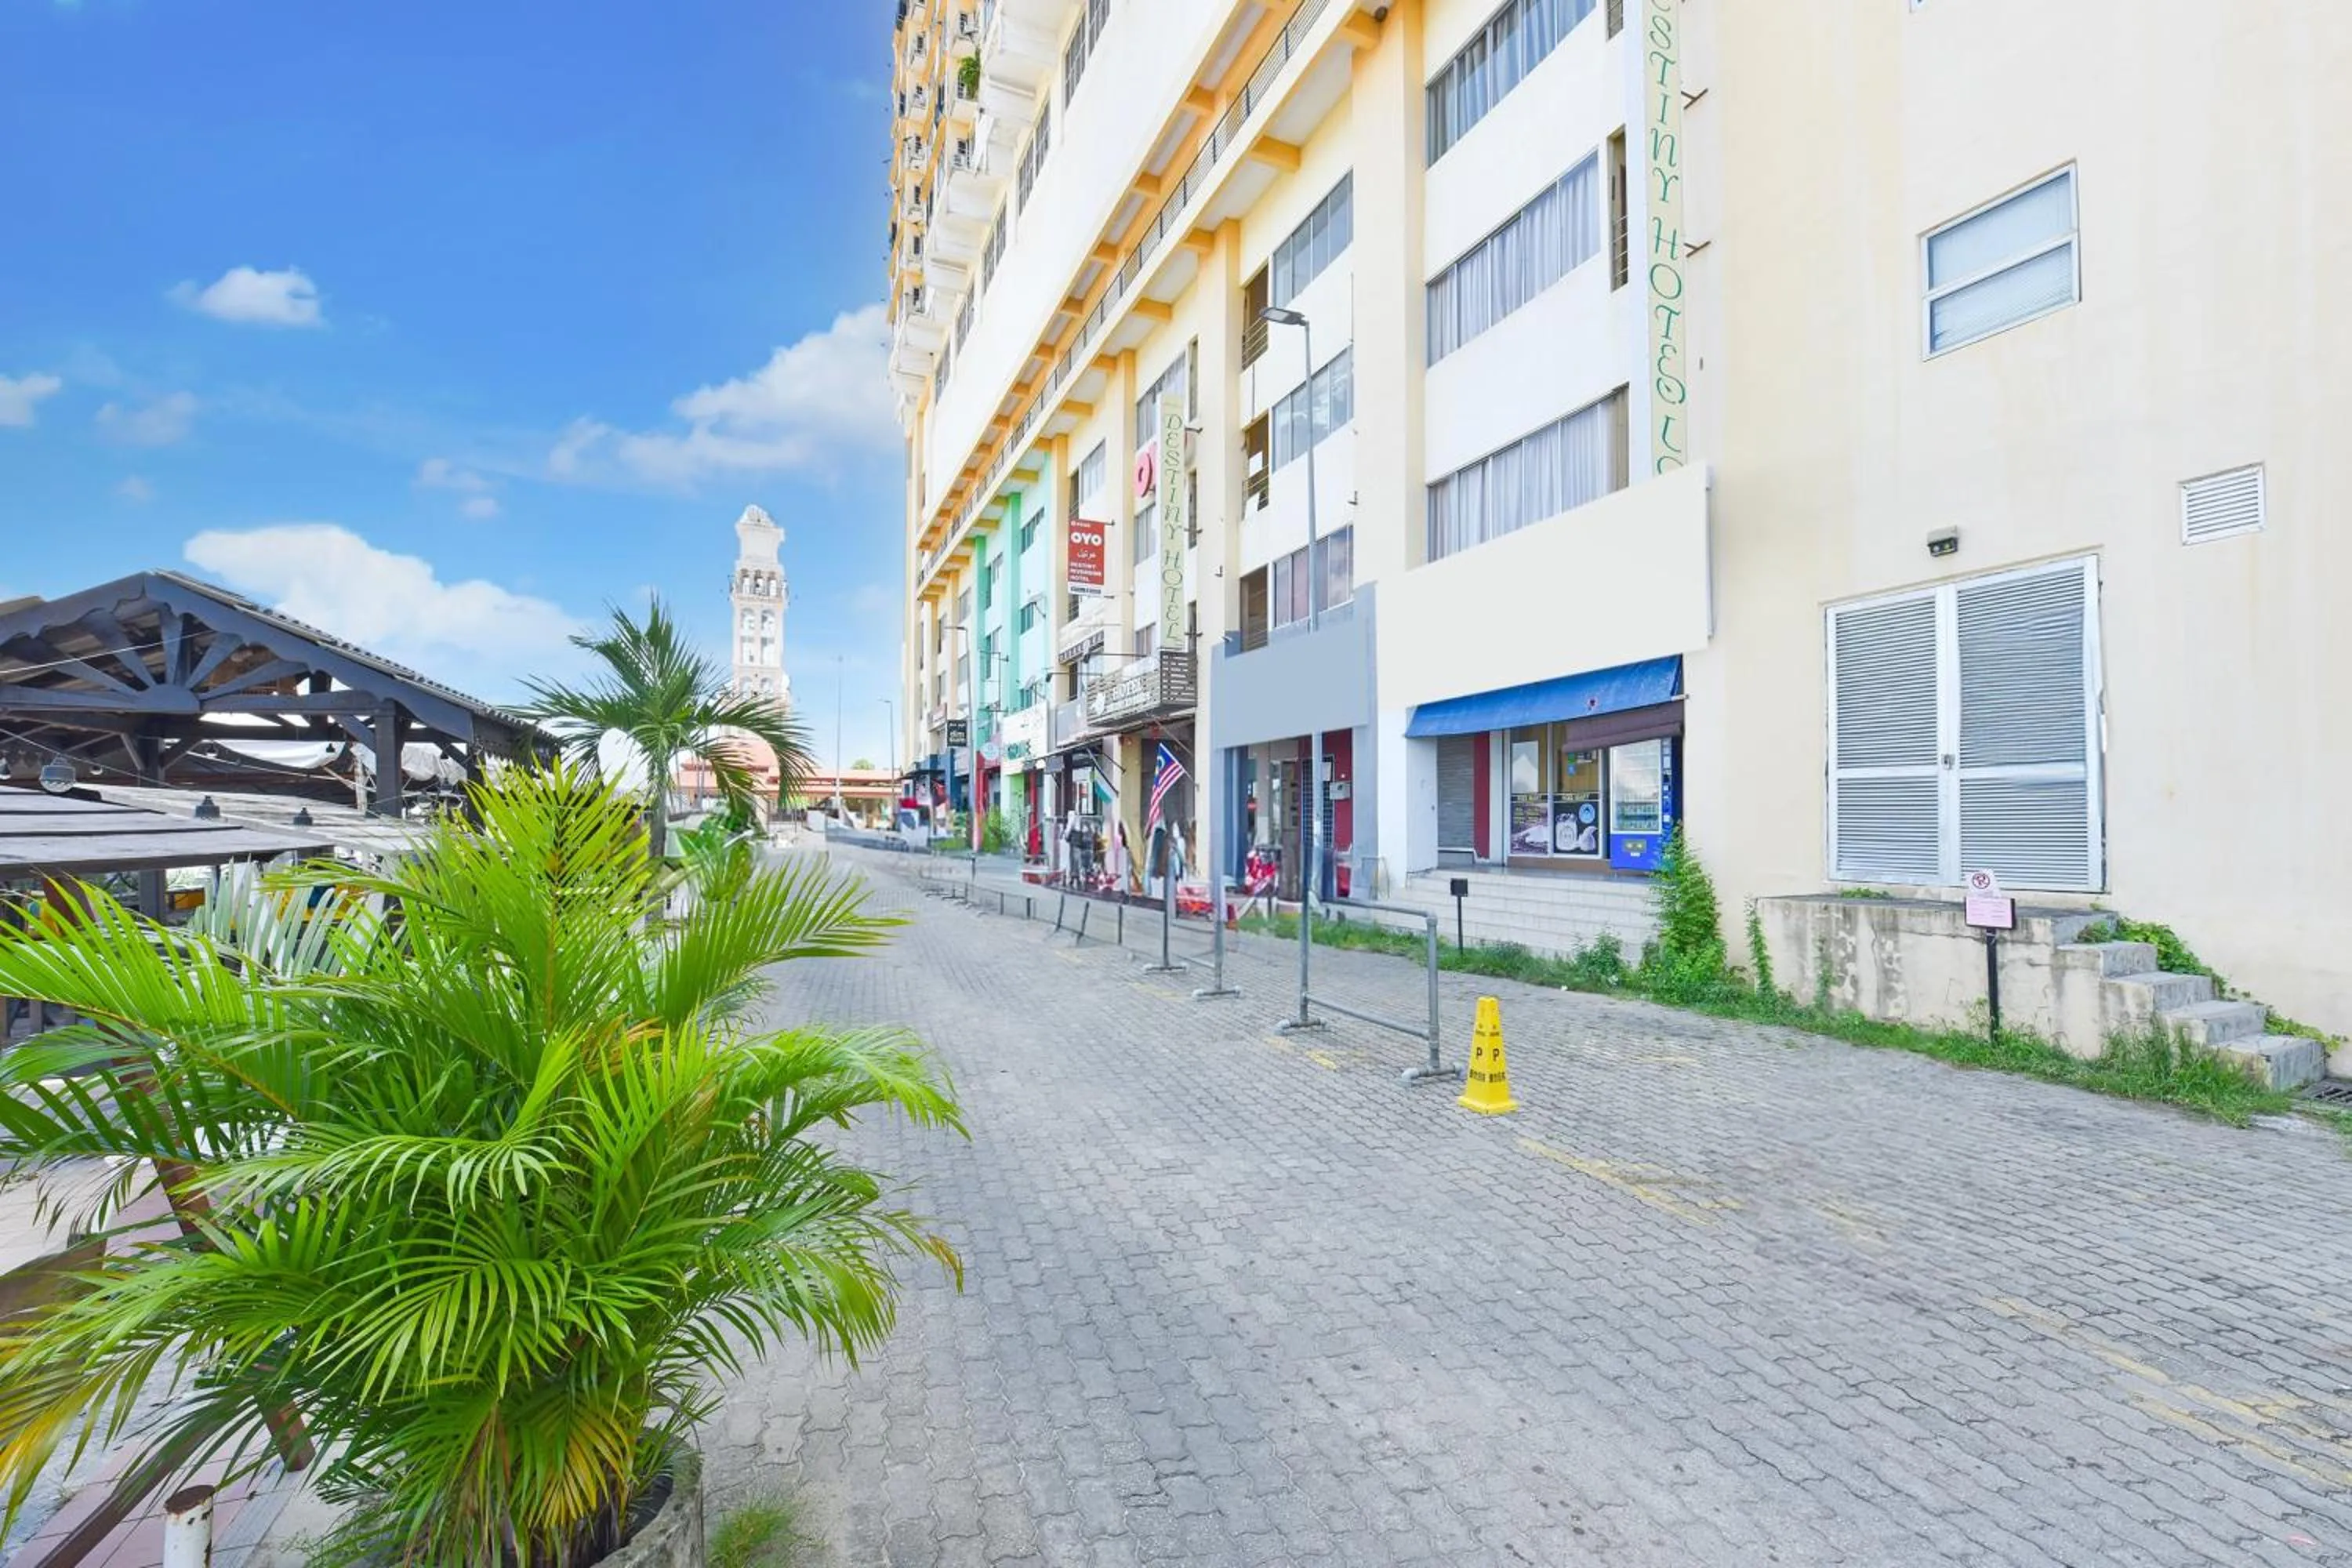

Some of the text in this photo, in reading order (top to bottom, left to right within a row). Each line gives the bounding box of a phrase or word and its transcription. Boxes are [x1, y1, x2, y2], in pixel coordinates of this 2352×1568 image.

[1070, 532, 1102, 546] OYO
[1162, 413, 1184, 641] DESTINY HOTEL
